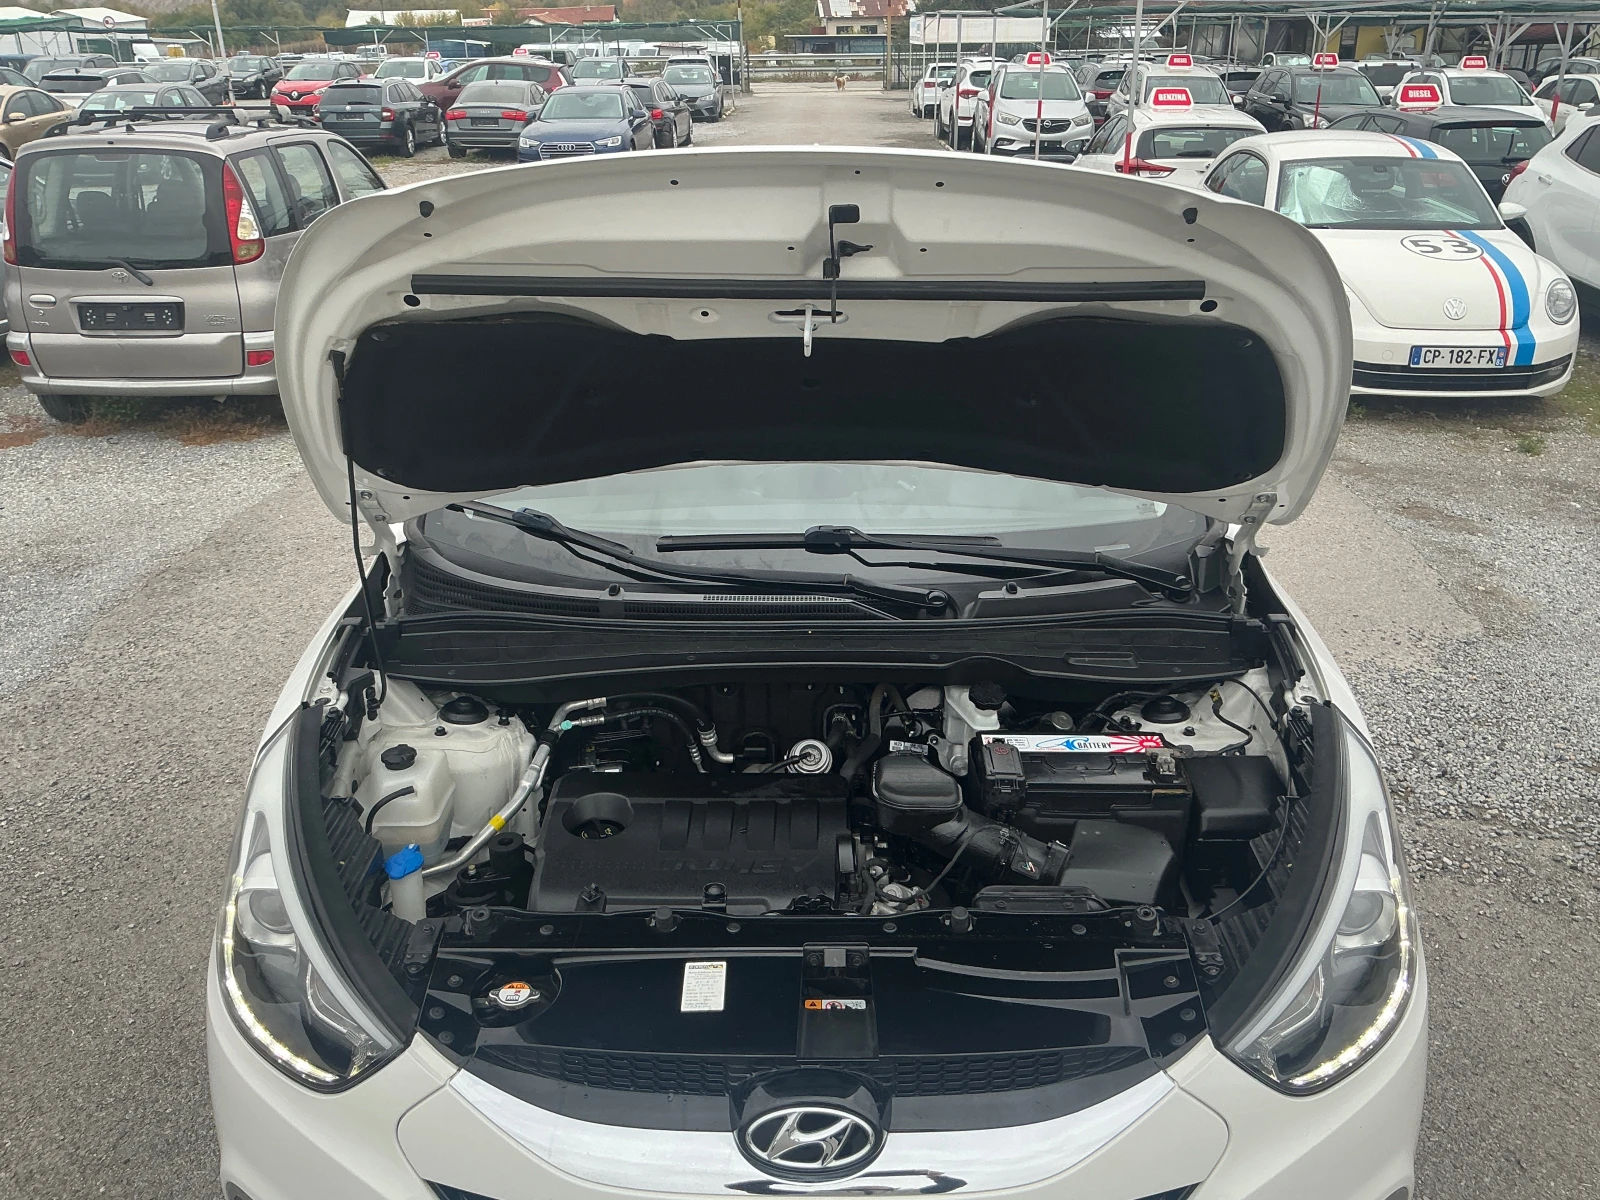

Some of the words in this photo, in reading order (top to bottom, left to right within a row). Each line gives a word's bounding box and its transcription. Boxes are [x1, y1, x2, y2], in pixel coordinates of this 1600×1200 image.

[1158, 93, 1187, 102] BENZINA
[1408, 90, 1432, 98] DIESEL
[1408, 239, 1478, 254] 53
[1423, 349, 1496, 364] CP-182-FX
[1495, 358, 1504, 366] 83
